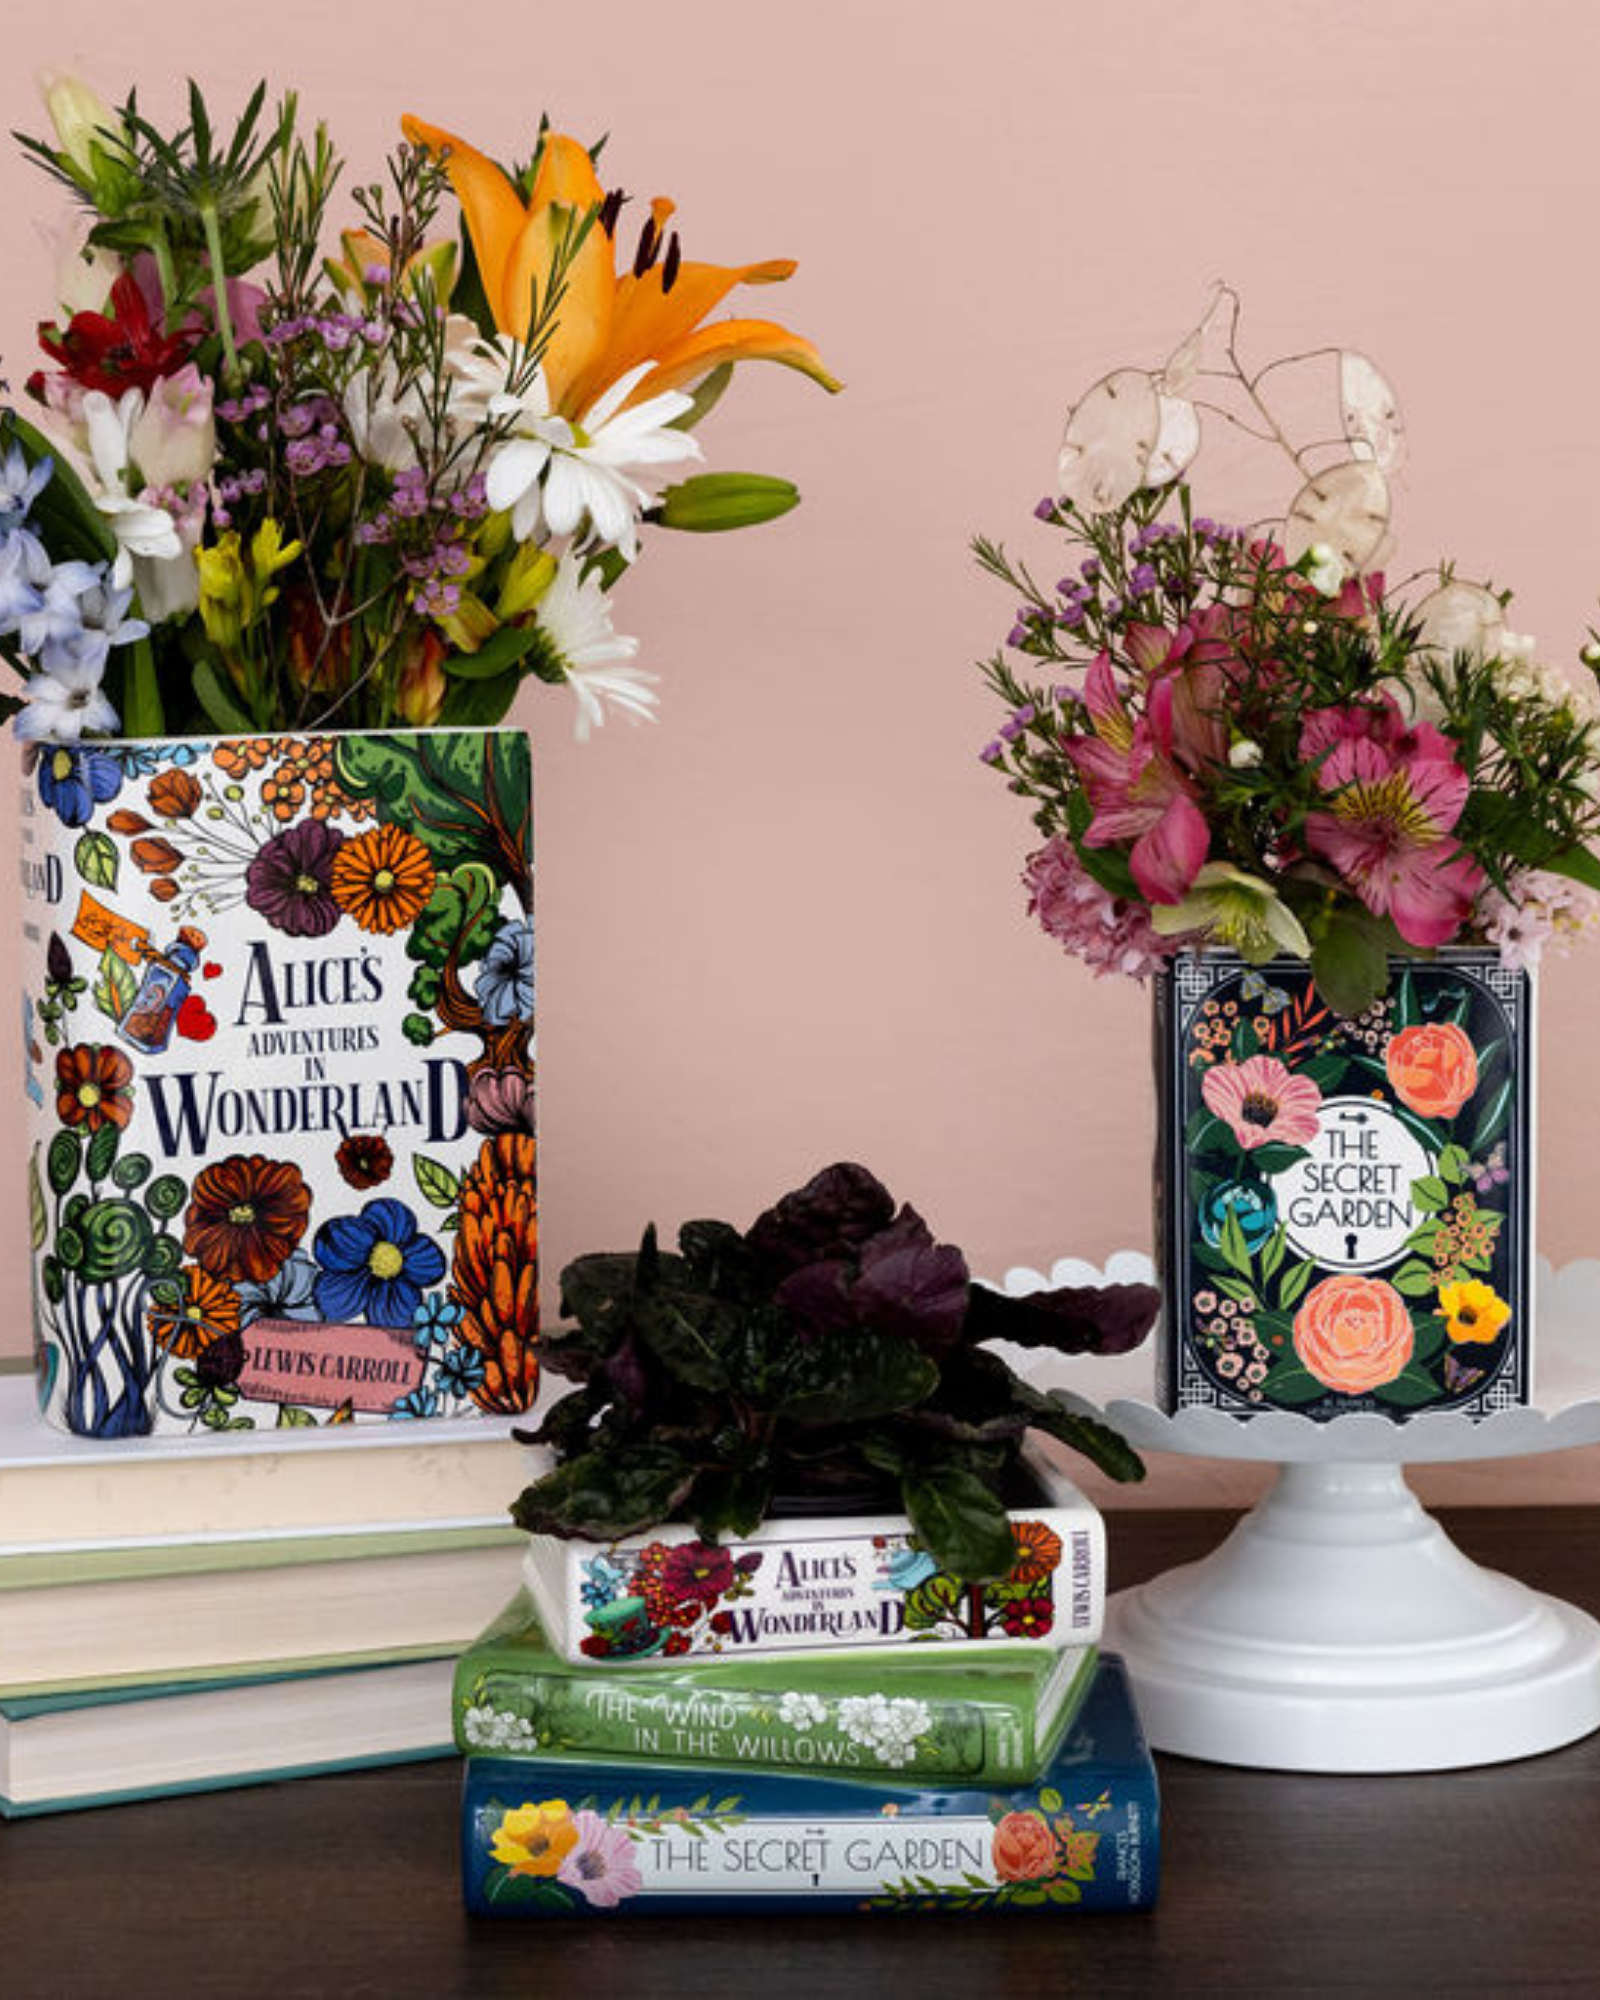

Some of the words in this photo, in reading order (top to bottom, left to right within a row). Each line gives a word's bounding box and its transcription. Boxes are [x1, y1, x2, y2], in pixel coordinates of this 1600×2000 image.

[233, 940, 383, 1027] ALICE'S
[247, 1025, 380, 1058] ADVENTURES
[304, 1056, 327, 1081] IN
[140, 1057, 469, 1157] WONDERLAND
[1325, 1130, 1378, 1159] THE
[1302, 1162, 1401, 1194] SECRET
[1288, 1196, 1412, 1228] GARDEN
[252, 1346, 315, 1377] LEWIS
[319, 1355, 410, 1385] CARROLL
[774, 1551, 857, 1589] ALICE'S
[730, 1600, 905, 1643] WONDERLAND
[1071, 1590, 1091, 1629] LEWIS
[586, 1687, 638, 1723] THE
[650, 1688, 737, 1729] WIND
[635, 1727, 659, 1751] IN
[673, 1729, 720, 1757] THE
[732, 1733, 860, 1765] WILLOWS
[651, 1839, 709, 1872] THE
[723, 1839, 829, 1872] SECRET
[844, 1839, 983, 1872] GARDEN
